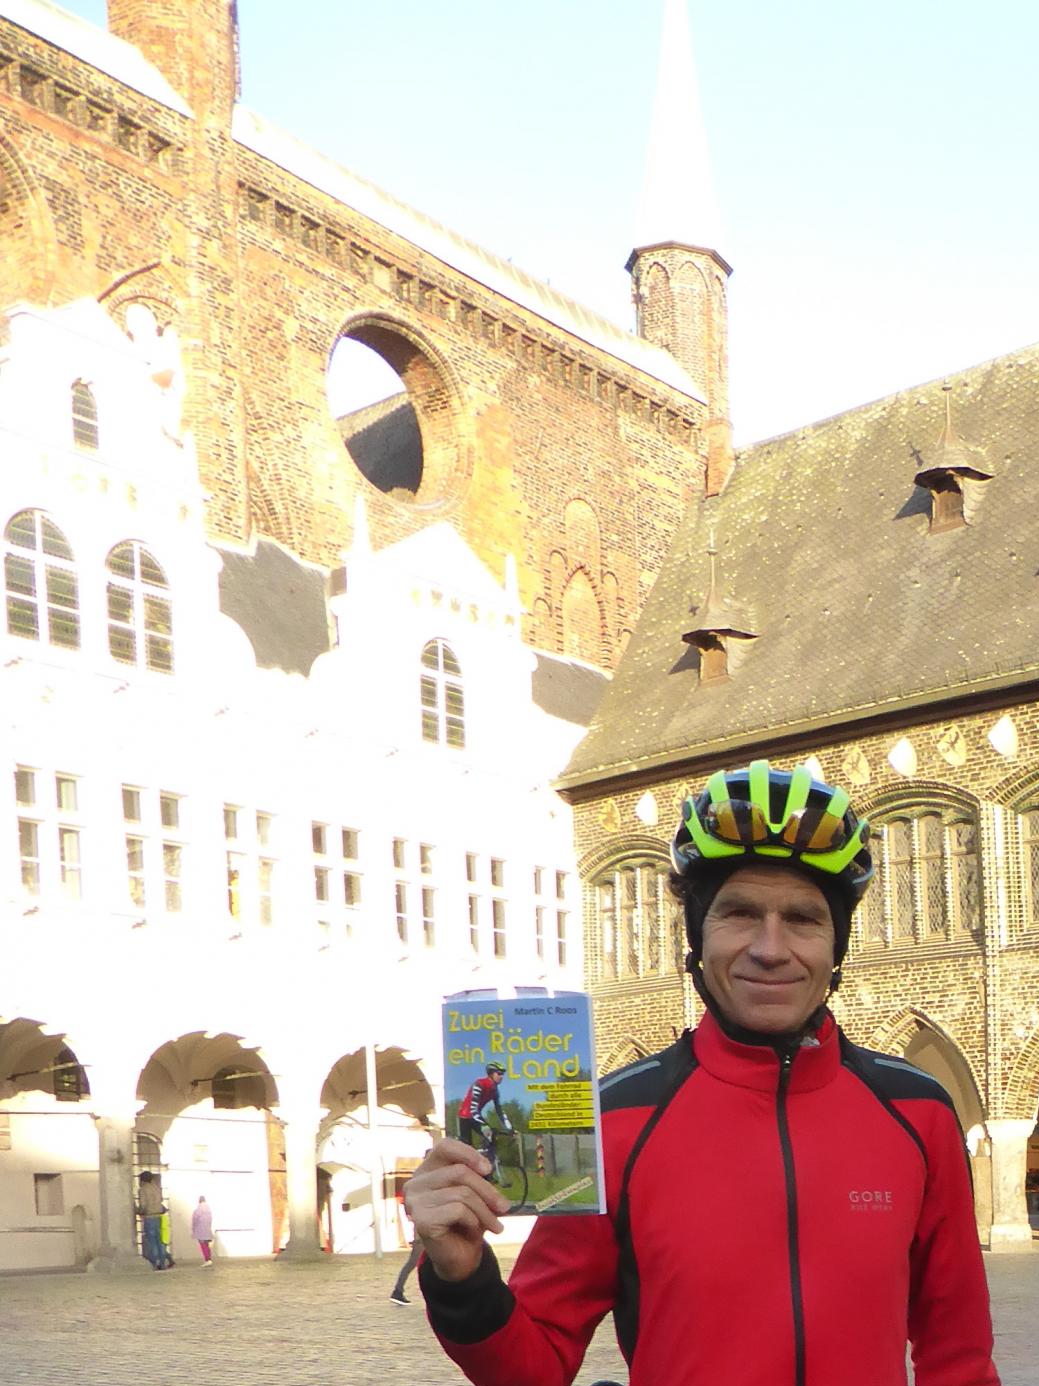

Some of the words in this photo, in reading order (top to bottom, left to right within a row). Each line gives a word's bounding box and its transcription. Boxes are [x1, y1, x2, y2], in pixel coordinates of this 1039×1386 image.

[448, 1009, 504, 1032] Zwei
[490, 1028, 573, 1054] Räder
[449, 1044, 485, 1065] ein
[507, 1054, 580, 1080] Land
[848, 1190, 894, 1203] GORE
